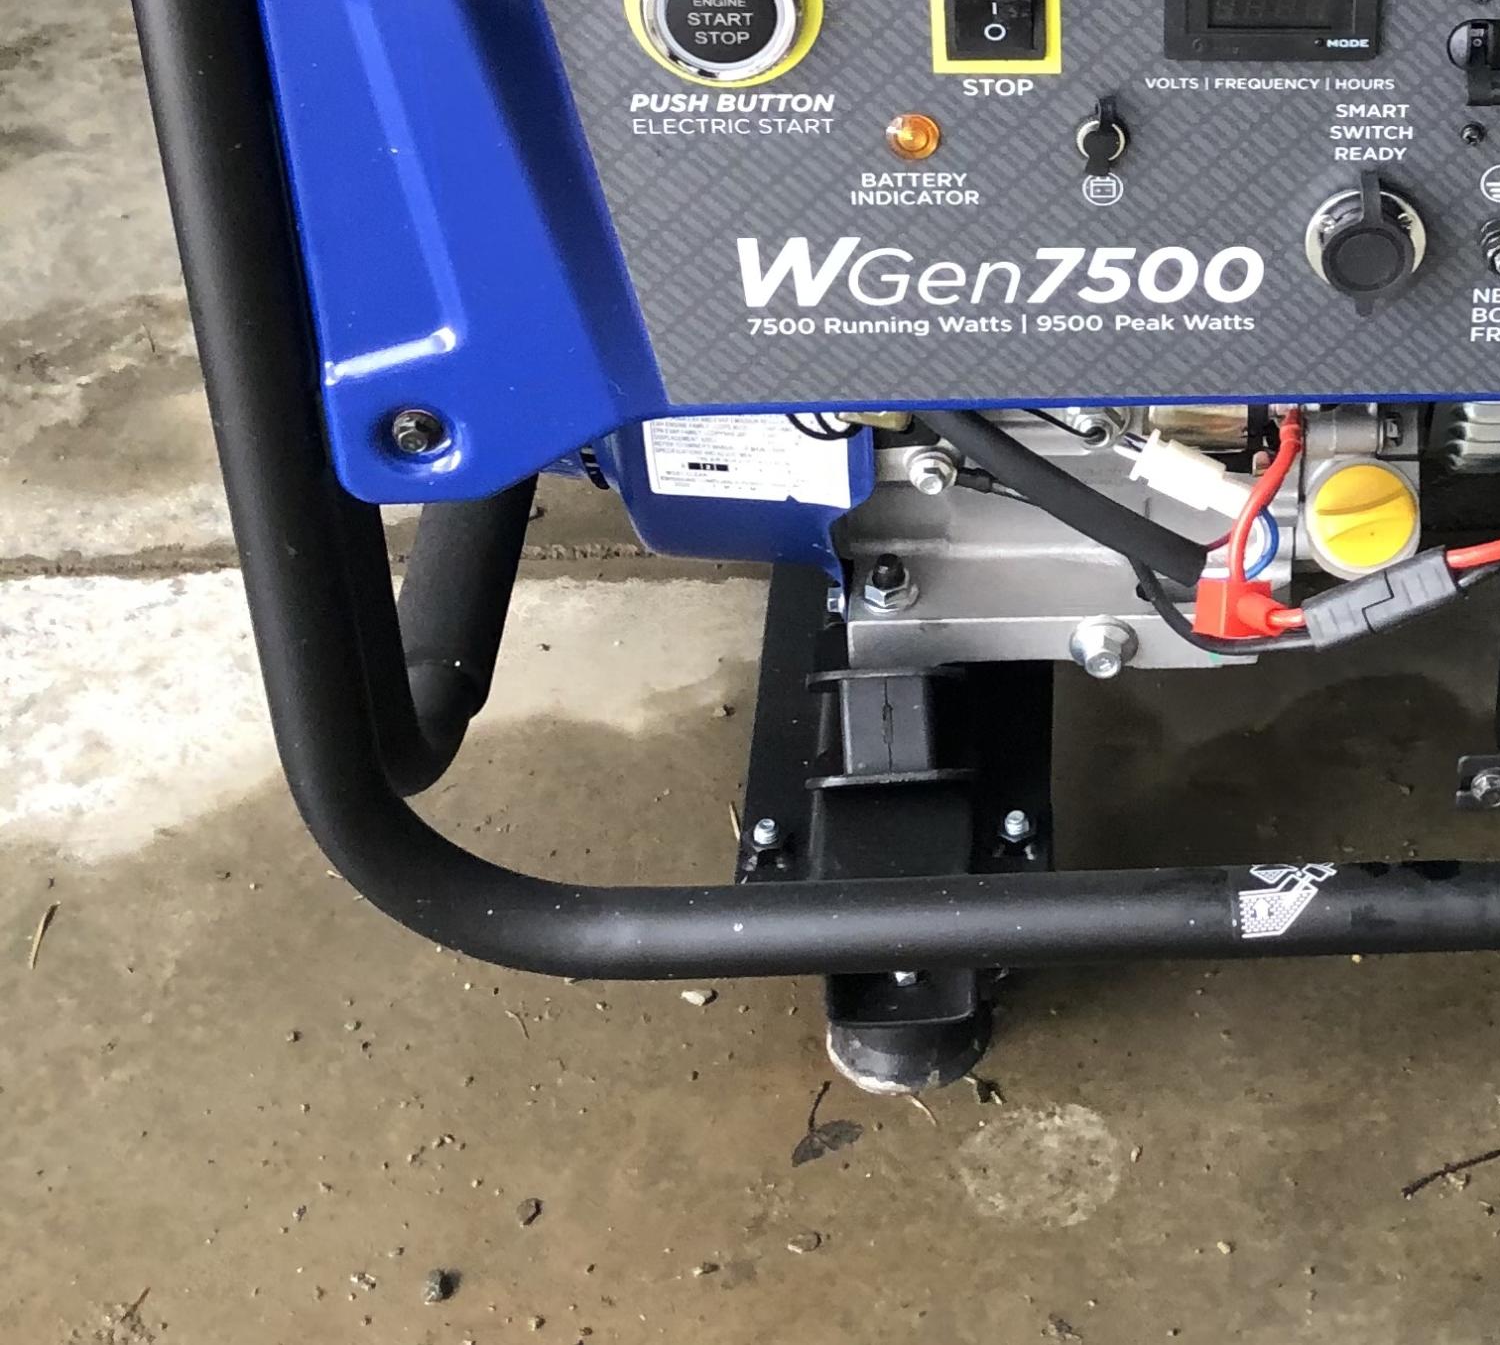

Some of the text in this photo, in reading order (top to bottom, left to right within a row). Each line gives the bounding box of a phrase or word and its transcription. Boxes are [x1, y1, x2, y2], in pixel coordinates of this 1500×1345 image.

[687, 12, 753, 26] START
[695, 31, 750, 45] STOP
[1326, 38, 1370, 48] MODE
[962, 79, 1034, 97] STOP
[1144, 77, 1200, 90] VOLTS
[1214, 77, 1321, 91] FREQUENCY
[1335, 78, 1395, 91] HOURS
[629, 93, 836, 113] PUSH BUTTON
[1335, 103, 1410, 119] SMART
[631, 118, 835, 135] ELECTRIC START
[1329, 125, 1414, 140] SWITCH
[1334, 146, 1407, 161] READY
[861, 172, 968, 188] BATTERY
[850, 189, 980, 206] INDICATOR
[736, 236, 1265, 308] WGen7500
[747, 317, 816, 336] 7500
[823, 316, 930, 337] Running
[937, 316, 1013, 333] Watts
[1036, 314, 1104, 332] 9500
[1115, 313, 1175, 331] Peak
[1182, 314, 1255, 331] Watts
